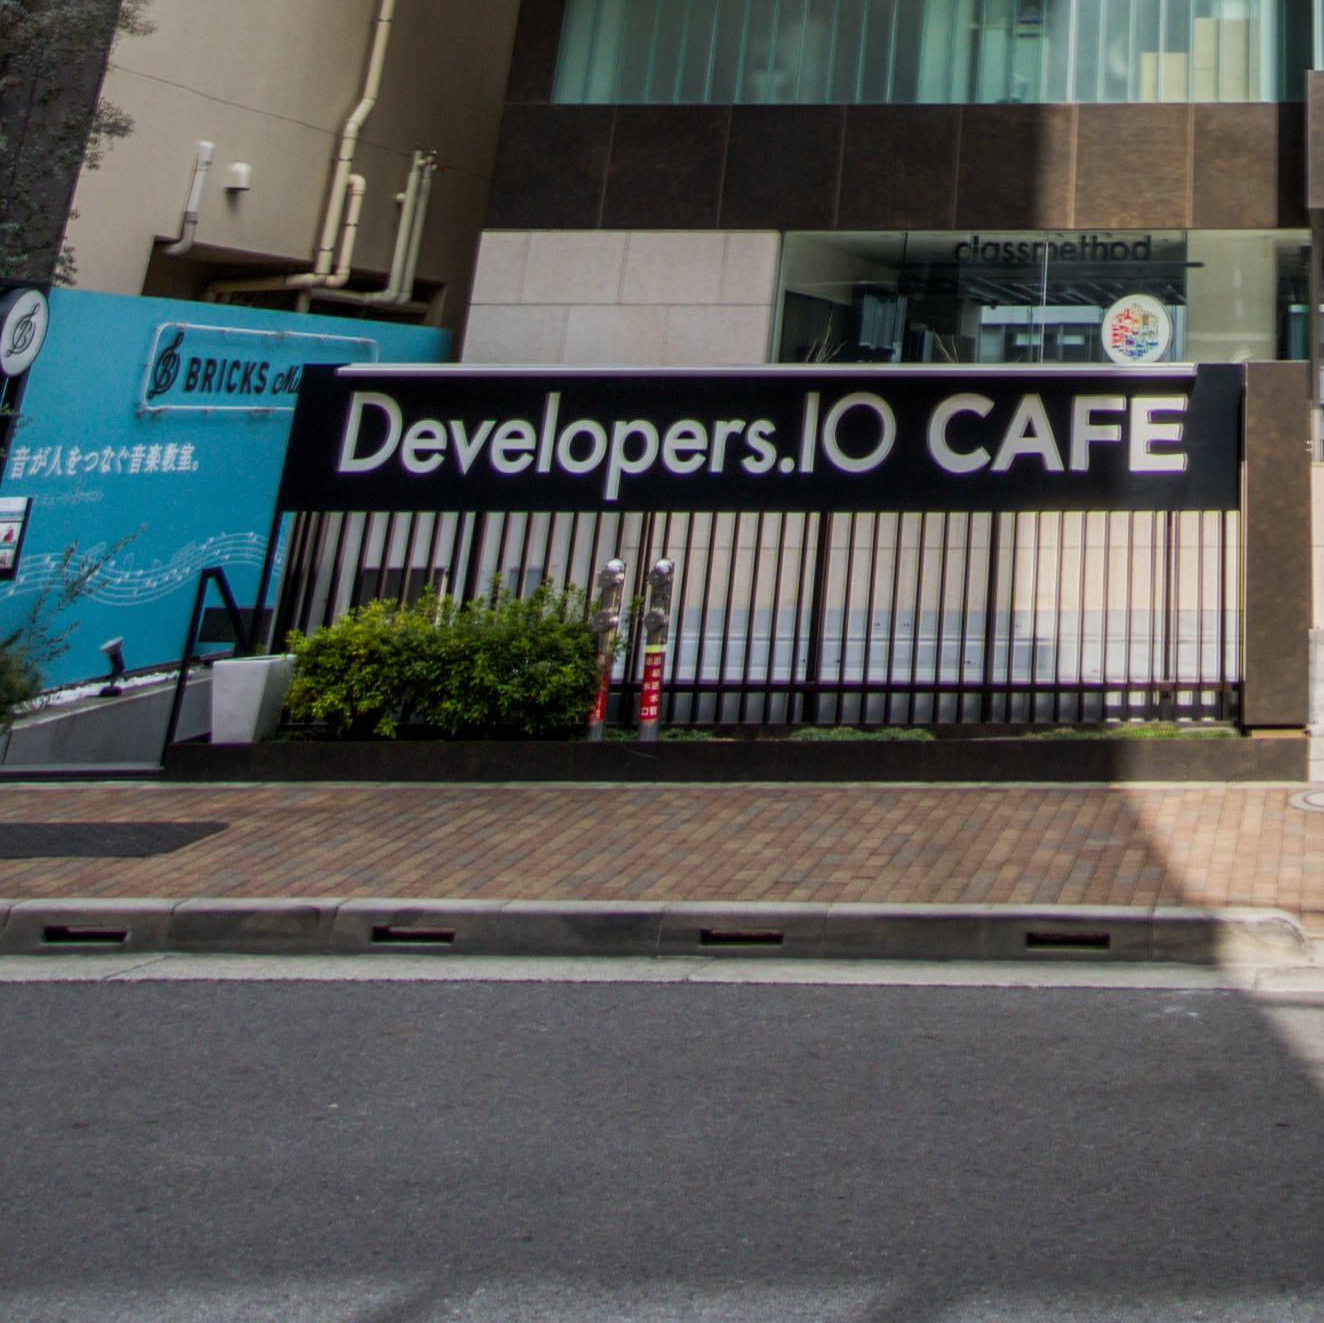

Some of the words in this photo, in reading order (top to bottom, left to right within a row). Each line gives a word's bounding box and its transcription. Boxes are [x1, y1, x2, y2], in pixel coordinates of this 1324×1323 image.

[954, 235, 1151, 261] classmethod
[184, 357, 270, 395] BRICKS
[9, 442, 199, 479] 音が人をつなぐ音楽教室。
[337, 391, 897, 501] Developers.IO
[926, 392, 1189, 474] CAFE
